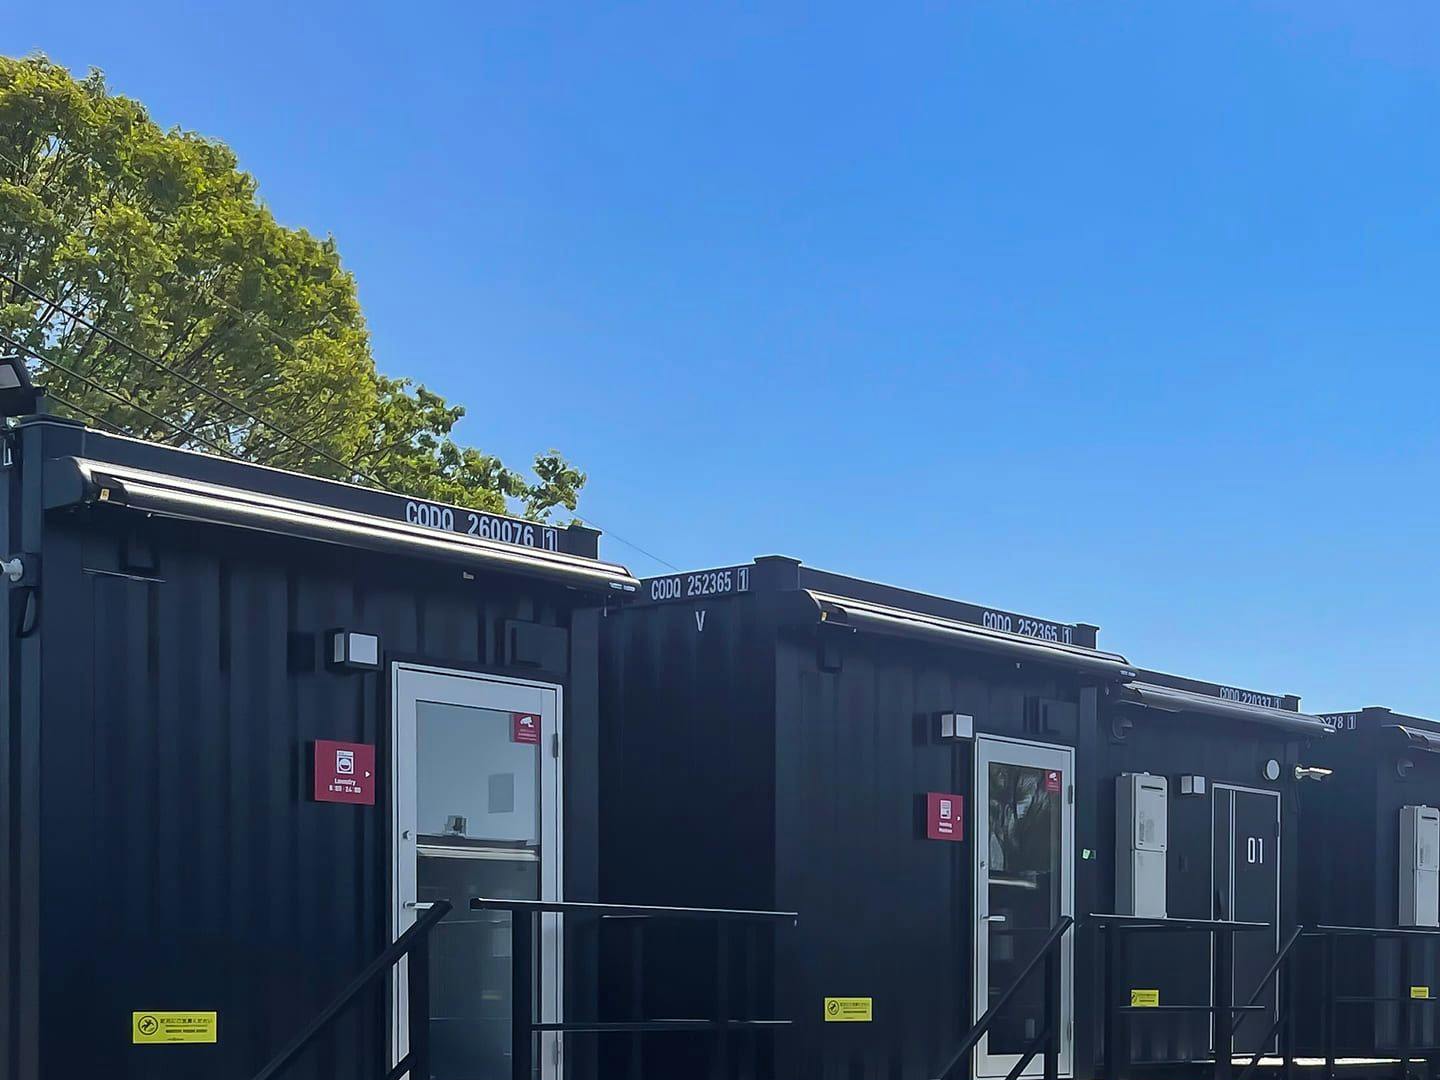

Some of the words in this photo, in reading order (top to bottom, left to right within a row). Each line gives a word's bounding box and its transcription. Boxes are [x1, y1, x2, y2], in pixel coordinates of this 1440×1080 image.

[467, 513, 534, 549] 260076
[651, 578, 681, 600] CODQ
[687, 571, 732, 596] 252365
[695, 610, 706, 632] V
[1018, 618, 1058, 643] 252365
[1247, 836, 1264, 864] 01
